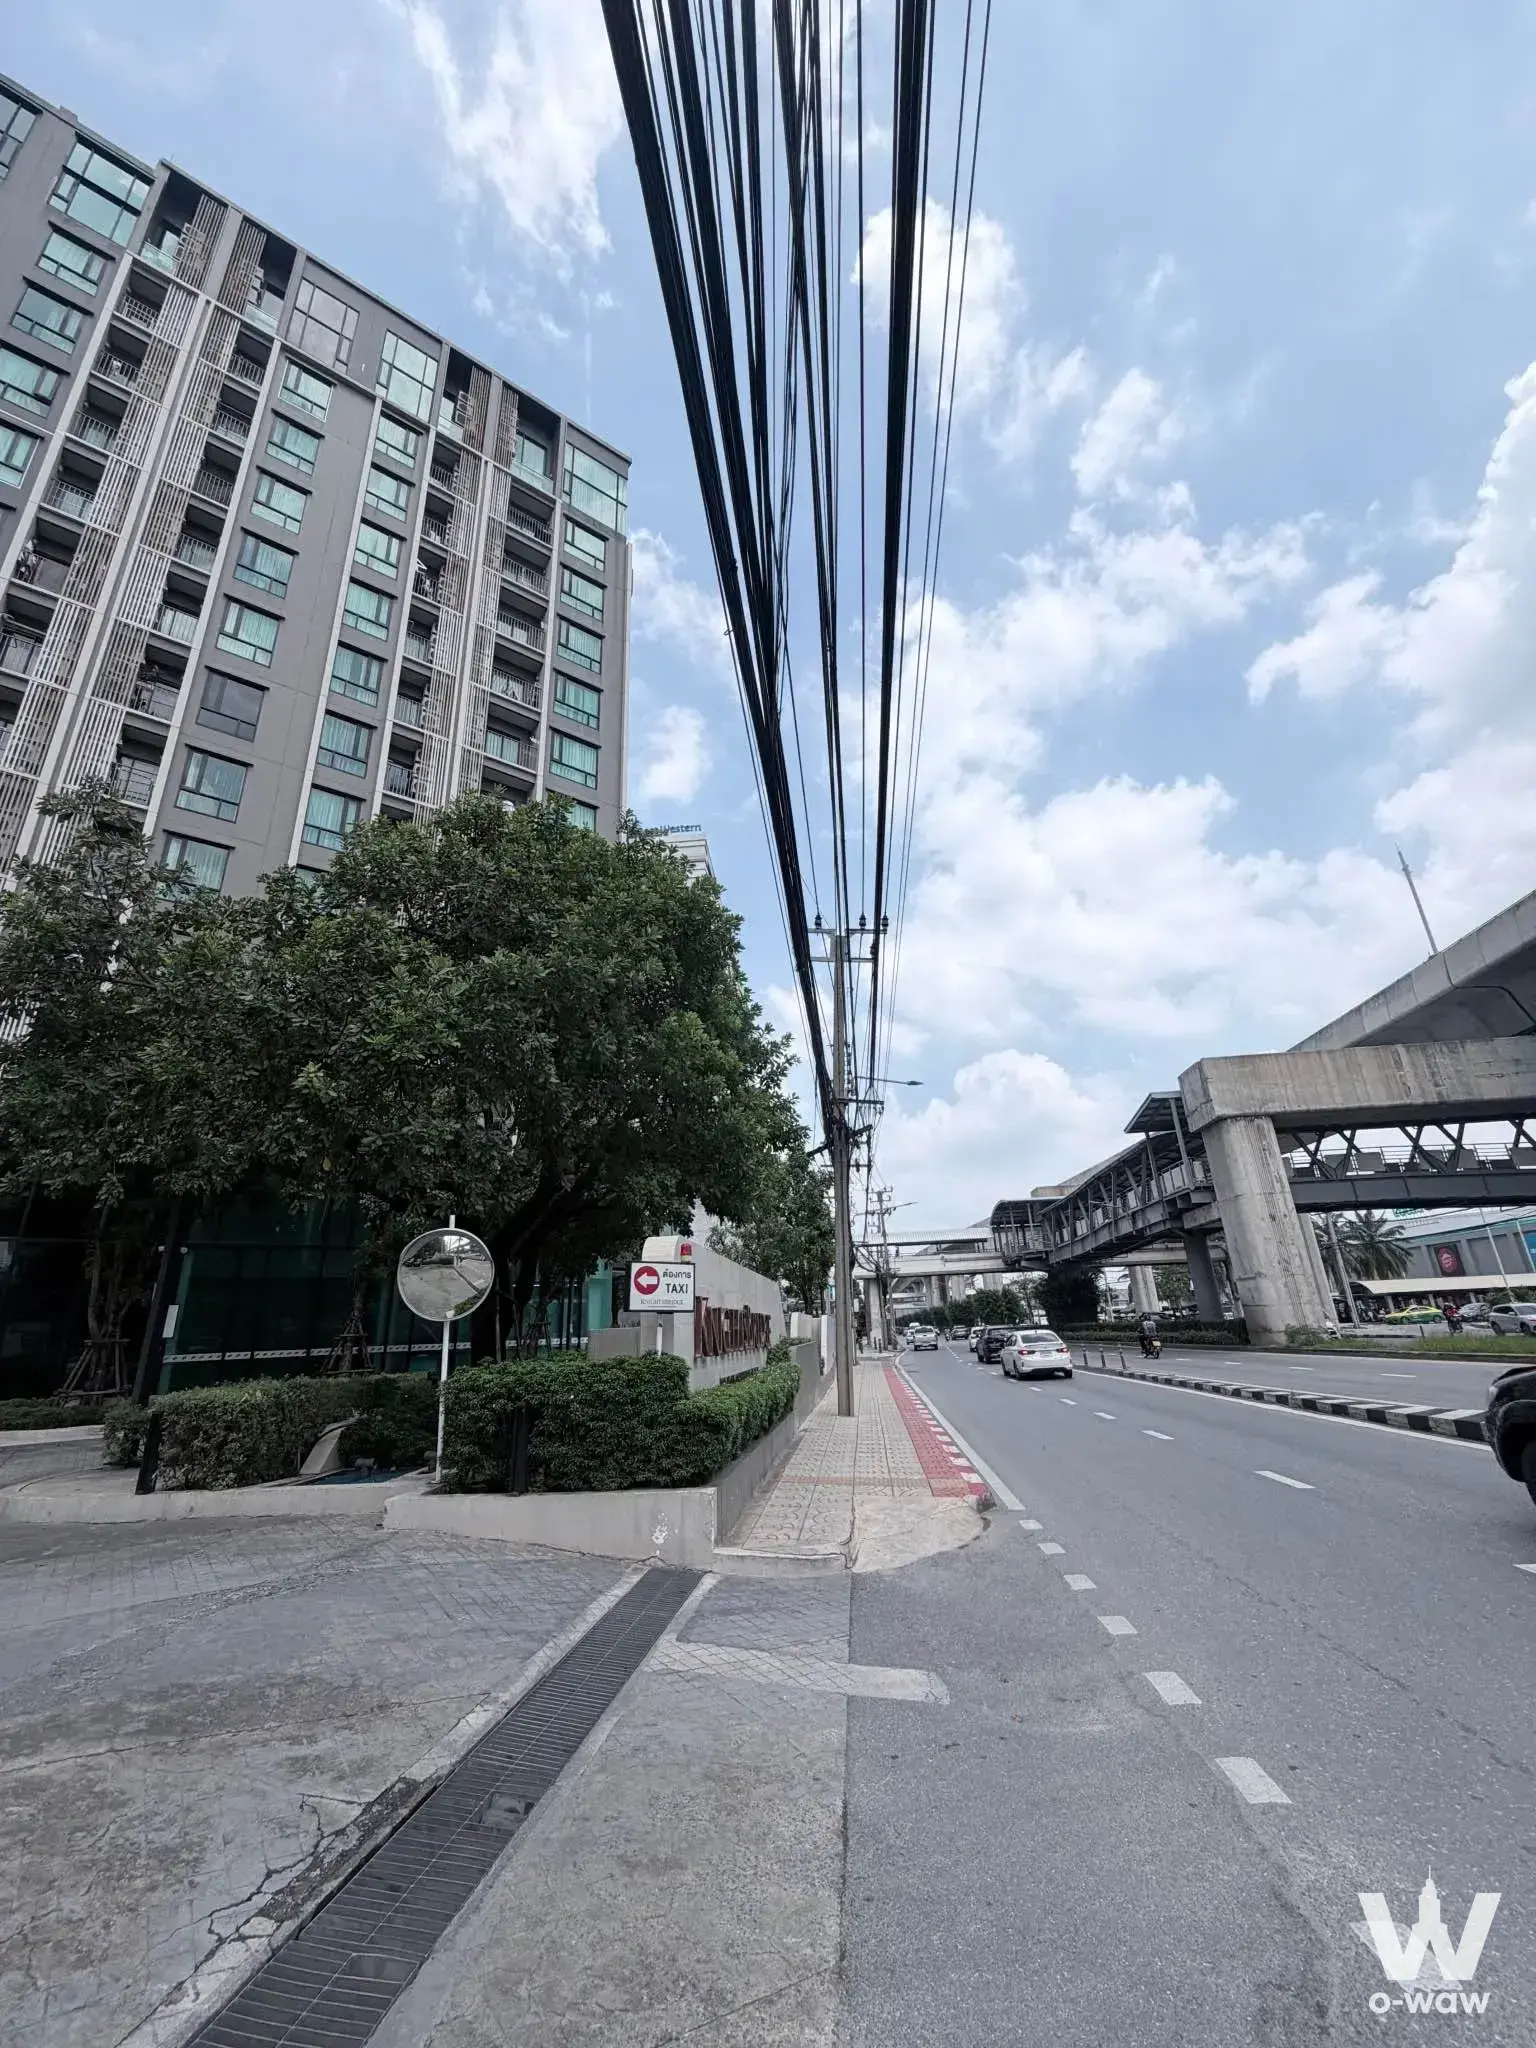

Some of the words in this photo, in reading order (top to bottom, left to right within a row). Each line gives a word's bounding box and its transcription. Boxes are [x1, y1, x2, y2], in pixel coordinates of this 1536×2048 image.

[662, 1268, 692, 1279] ต้องการ
[665, 1283, 689, 1294] TAXI
